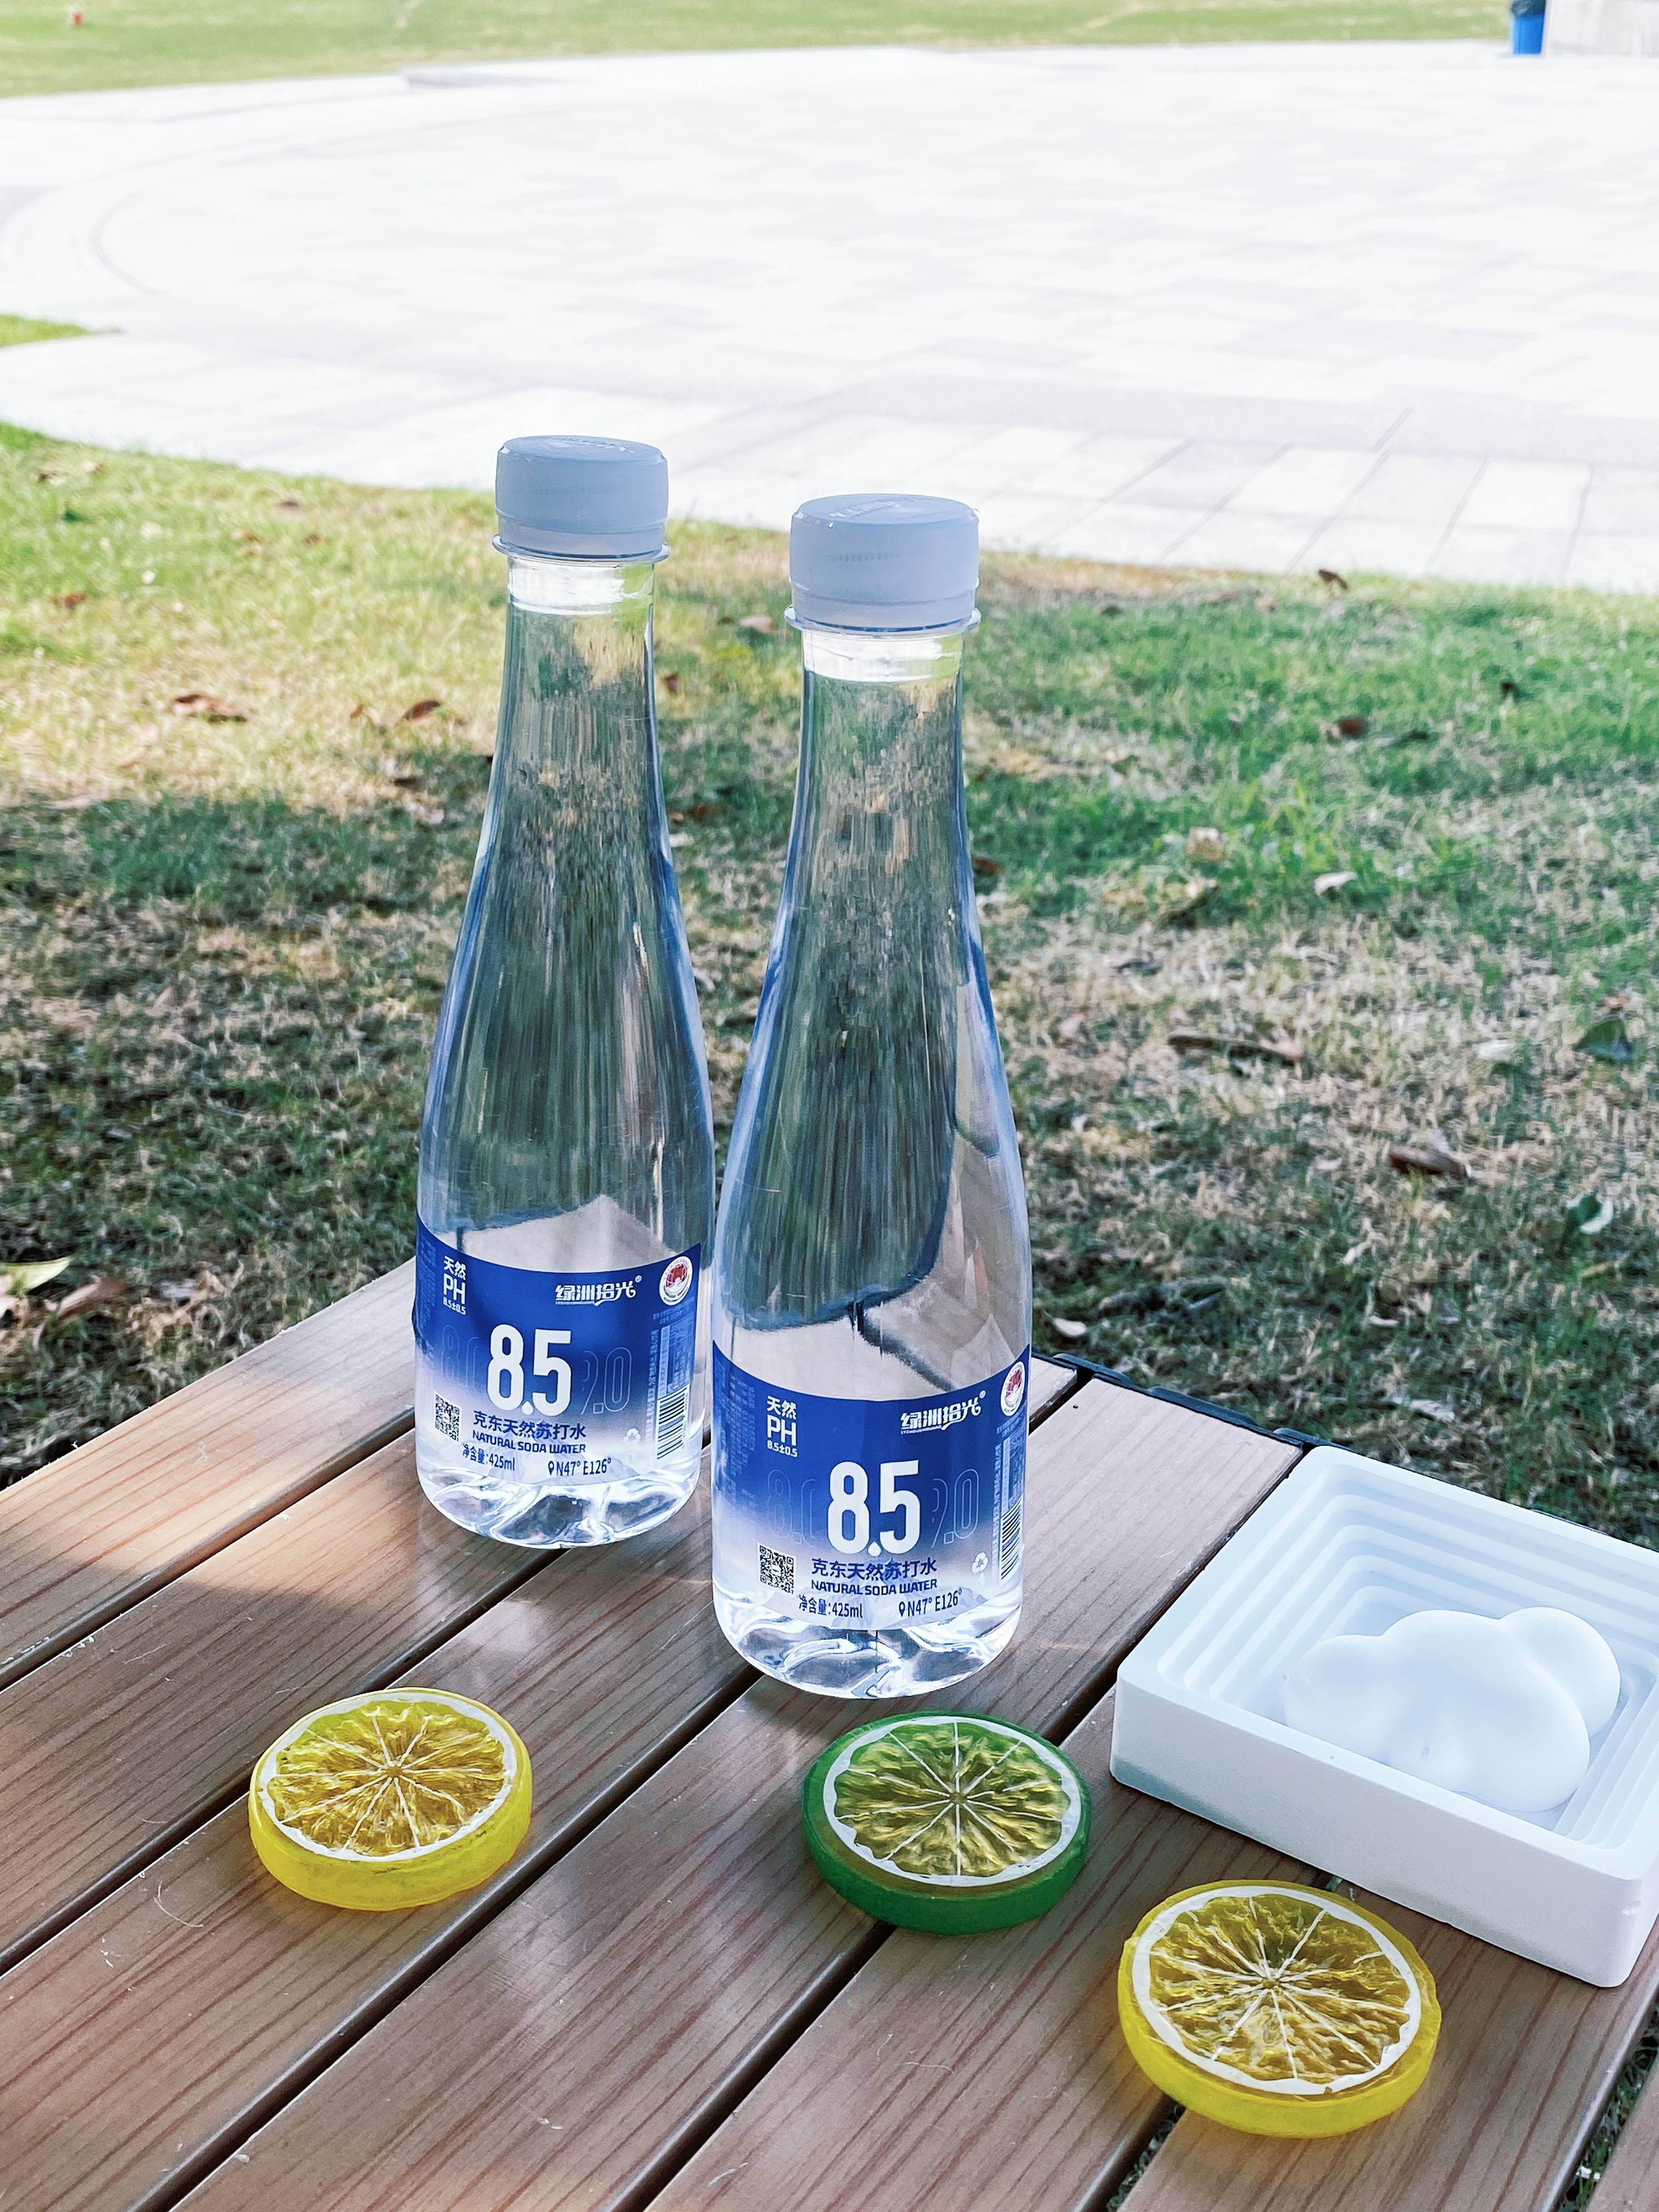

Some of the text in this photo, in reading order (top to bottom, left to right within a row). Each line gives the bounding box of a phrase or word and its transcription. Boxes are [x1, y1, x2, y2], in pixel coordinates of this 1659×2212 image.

[443, 1255, 466, 1280] 天然
[443, 1273, 466, 1305] PH
[555, 1280, 636, 1307] 绿洲拾光
[487, 1324, 572, 1417] 8.5
[766, 1395, 797, 1420] 天然
[900, 1396, 981, 1431] 绿洲拾光
[473, 1409, 587, 1440] 克东天然苏打水
[767, 1414, 797, 1447] PH
[472, 1429, 586, 1454] NATURAL SODA WATER
[766, 1440, 798, 1458] 8.5±0.5
[556, 1457, 612, 1476] N47° E126°
[828, 1459, 921, 1557] 8.5
[811, 1556, 938, 1581] 克东天然苏打水
[811, 1578, 938, 1596] NATURAL SODA WATER
[907, 1587, 963, 1617] N47° E126°
